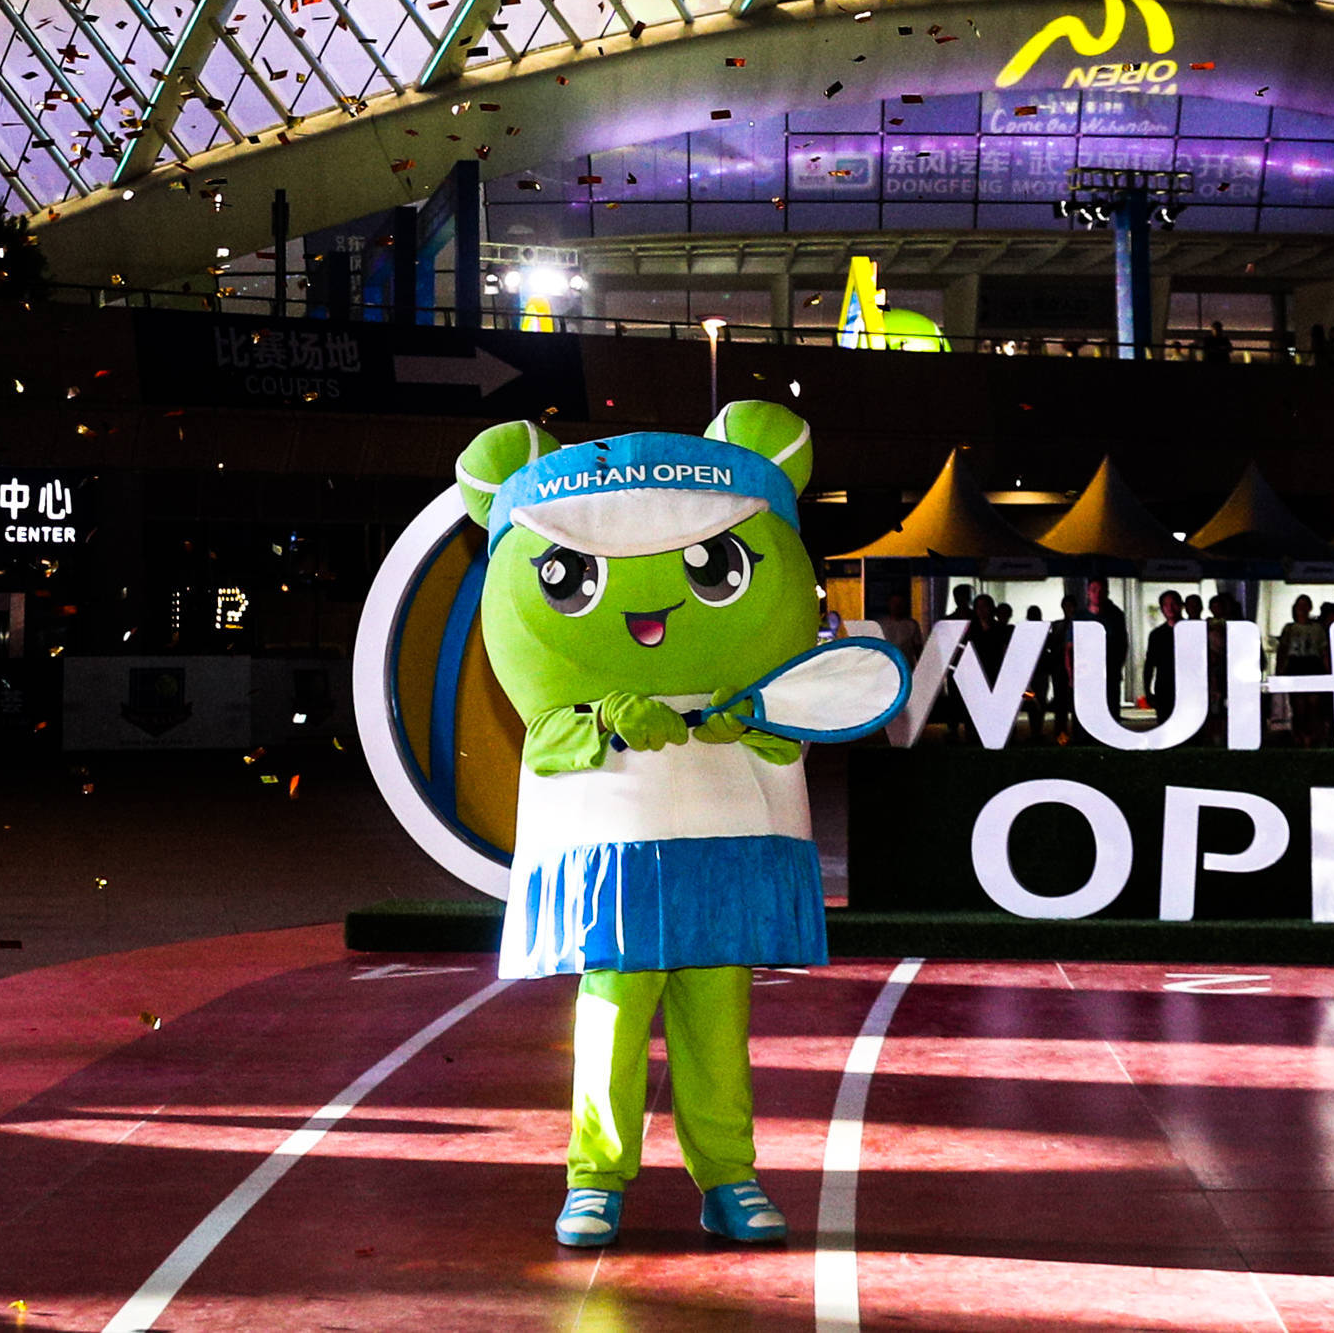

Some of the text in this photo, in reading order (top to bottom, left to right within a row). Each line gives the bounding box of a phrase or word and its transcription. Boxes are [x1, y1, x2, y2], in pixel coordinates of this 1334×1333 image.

[886, 178, 1003, 195] DONGFENG
[1011, 180, 1075, 196] MOTO
[1198, 183, 1260, 199] OEN
[212, 324, 363, 374] 比赛场地
[244, 374, 341, 399] COURTS
[537, 464, 733, 499] WUHAN OPEN
[5, 525, 77, 544] CENTER
